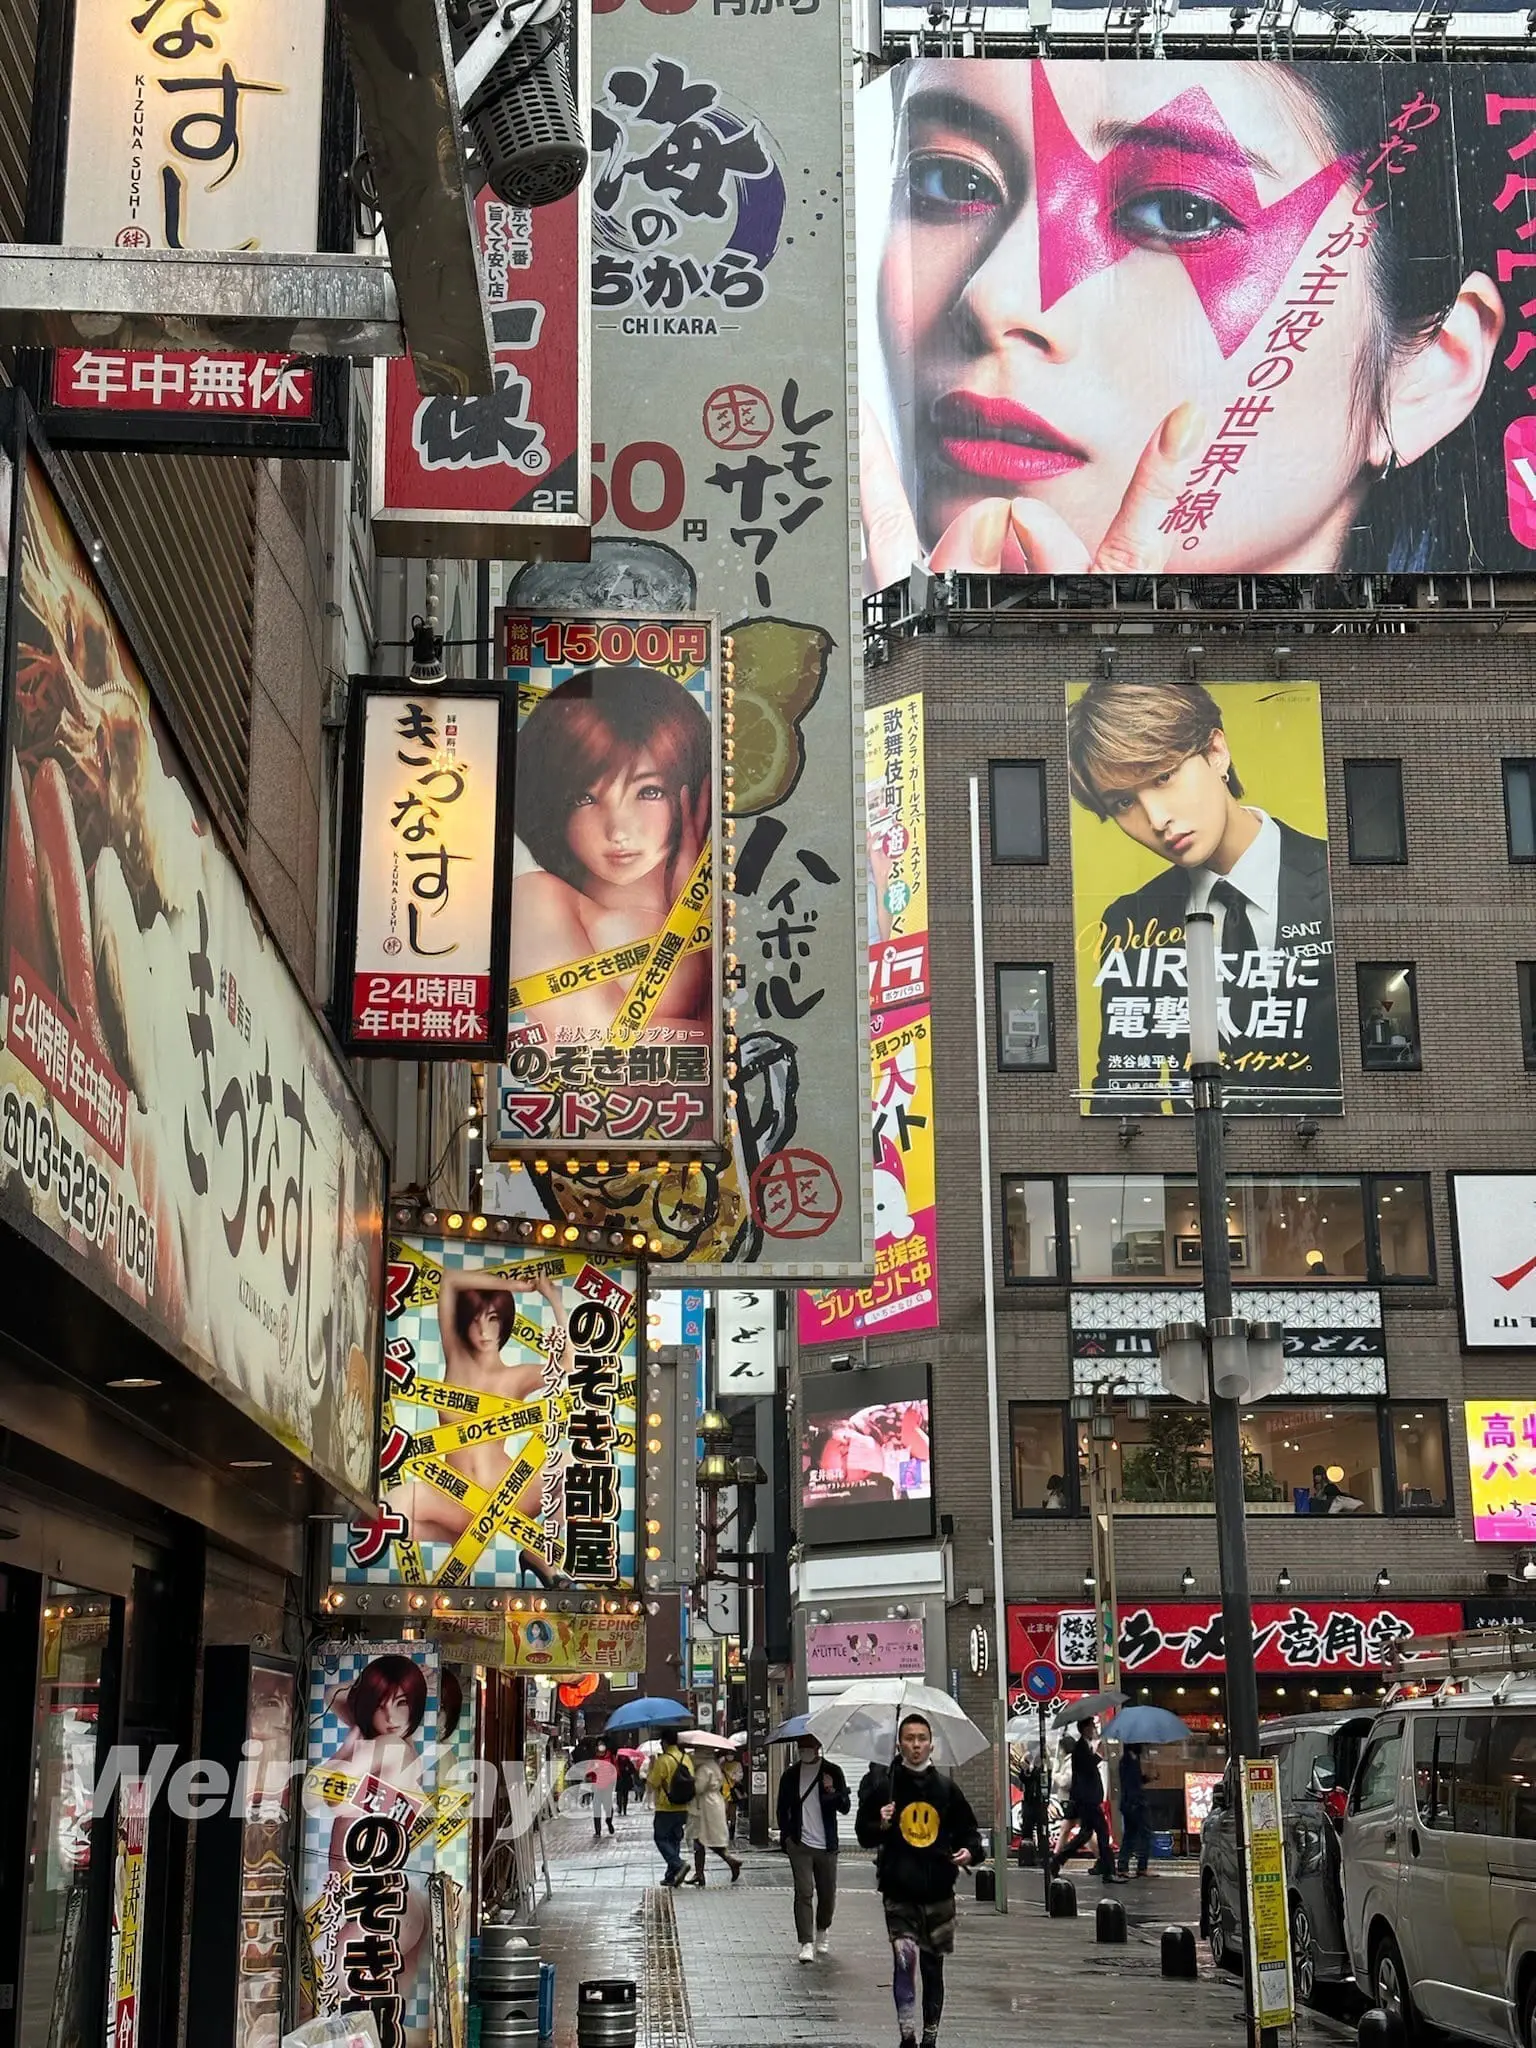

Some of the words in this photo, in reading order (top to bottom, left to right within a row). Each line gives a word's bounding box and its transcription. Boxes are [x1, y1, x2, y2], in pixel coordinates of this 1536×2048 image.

[131, 75, 145, 150] KIZUNA
[129, 156, 142, 220] SUSHI
[488, 205, 504, 298] 旨くて安い店
[622, 317, 718, 335] CHIKARA
[1157, 92, 1440, 551] わたしが主役の世界線。
[71, 350, 304, 410] 年中無休
[778, 378, 834, 534] レモン
[532, 490, 574, 511] 2F
[704, 455, 785, 608] サワー
[511, 623, 529, 661] 総額
[534, 624, 705, 663] 1500円
[391, 703, 473, 956] きづなすし
[392, 851, 400, 893] KIZUNA
[390, 897, 398, 934] SUSHI
[733, 815, 841, 1019] ハイボール
[1281, 921, 1322, 939] SAINT
[369, 978, 477, 1008] 24時間
[628, 930, 686, 1020] のぞき部屋
[359, 1008, 485, 1040] 年中無休
[555, 1026, 705, 1043] 素人ストリップショー
[871, 1024, 927, 1061] 見つかる
[12, 975, 69, 1094] 24時間
[70, 1037, 124, 1153] 年中無休
[510, 1045, 711, 1086] のぞき部屋
[184, 889, 325, 1391] きづなすし
[507, 1092, 705, 1140] マドンナ
[22, 1095, 155, 1297] 03-5287-1081
[239, 1273, 261, 1320] KIZUNA
[262, 1298, 280, 1341] SUSHI
[728, 1291, 766, 1378] うどん
[467, 1405, 545, 1440] のぞき部屋
[540, 1326, 568, 1566] 素人ストリップショー
[566, 1301, 623, 1581] のぞき部屋
[478, 1459, 535, 1535] のぞき部屋
[578, 1619, 641, 1631] PEEPING
